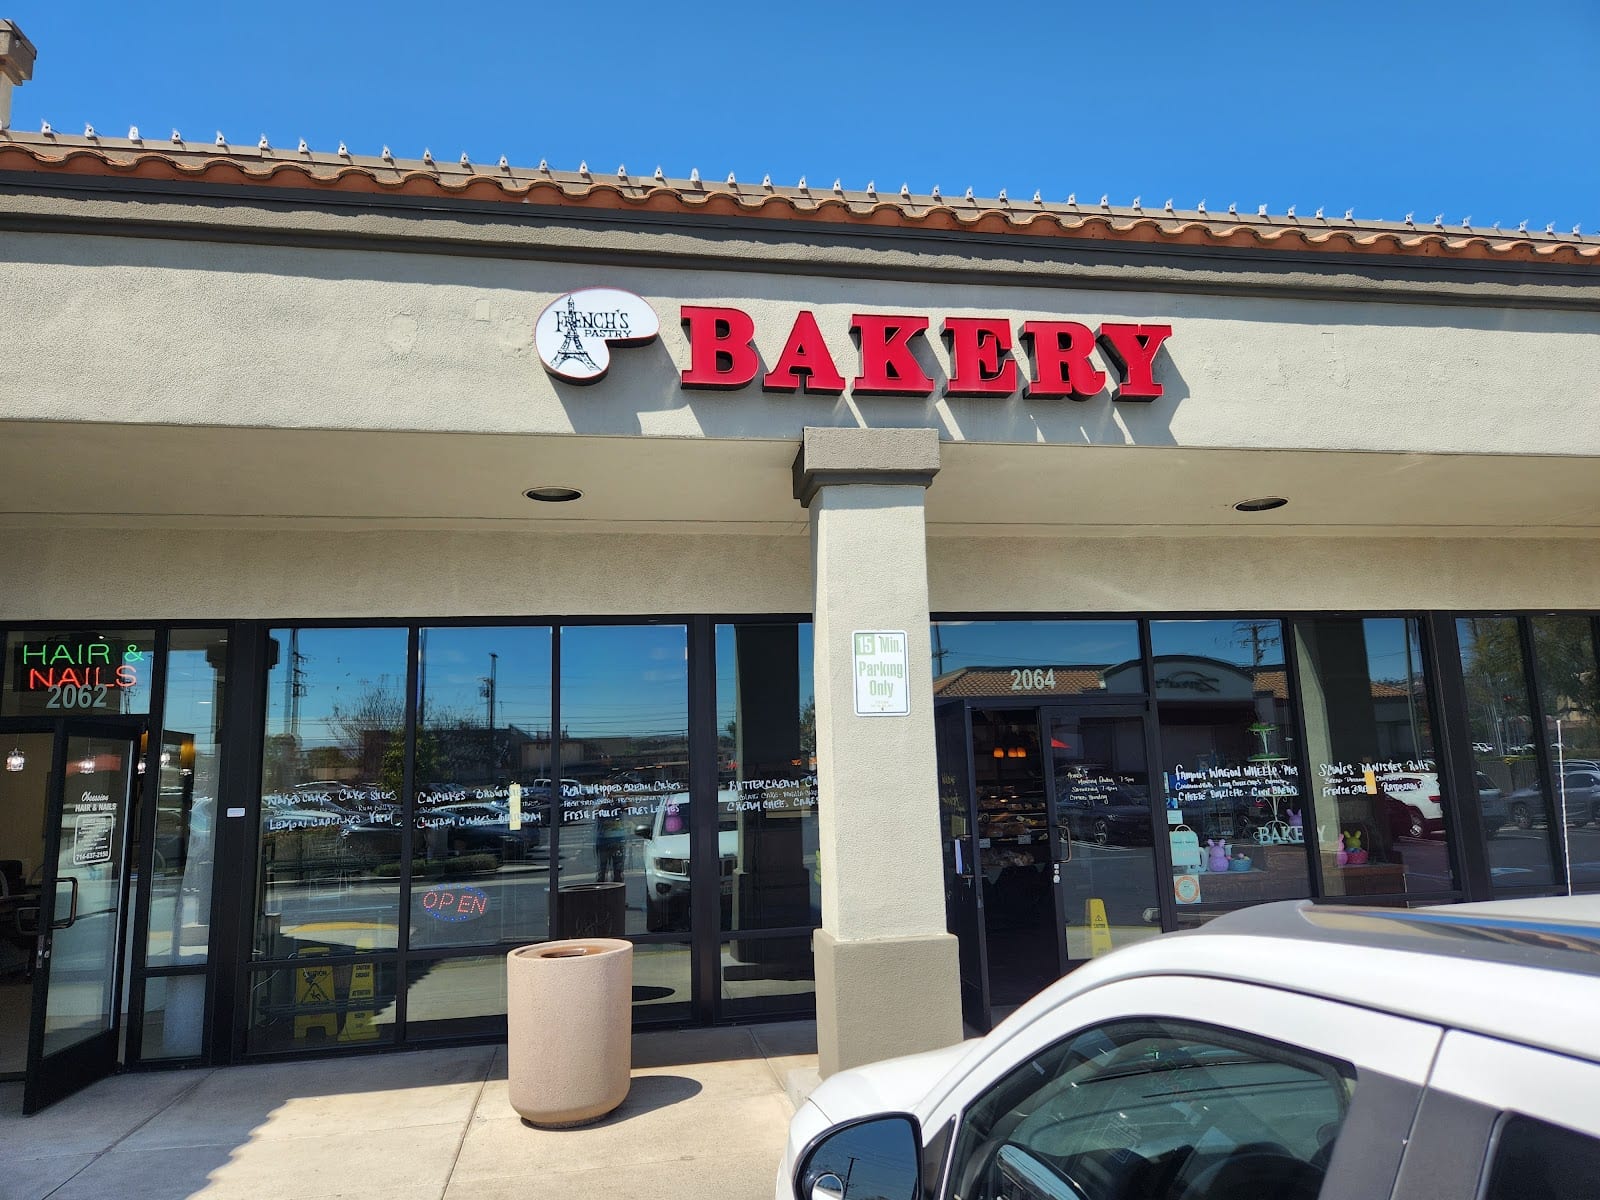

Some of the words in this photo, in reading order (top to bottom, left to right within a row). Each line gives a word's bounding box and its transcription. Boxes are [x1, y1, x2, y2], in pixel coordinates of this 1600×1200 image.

[553, 309, 629, 332] FRENCH'S
[584, 329, 632, 338] PASTRY
[680, 305, 1173, 402] BAKERY
[23, 644, 112, 665] HAIR
[124, 644, 145, 663] &
[859, 634, 873, 654] 15
[879, 636, 903, 653] Min.
[29, 664, 138, 690] NAILS
[858, 661, 904, 679] Parking
[1010, 668, 1057, 691] 2064
[46, 684, 108, 709] 2062
[869, 680, 894, 698] Only
[75, 803, 91, 812] HAIR
[99, 803, 117, 811] NAILS
[423, 892, 487, 915] OPEN
